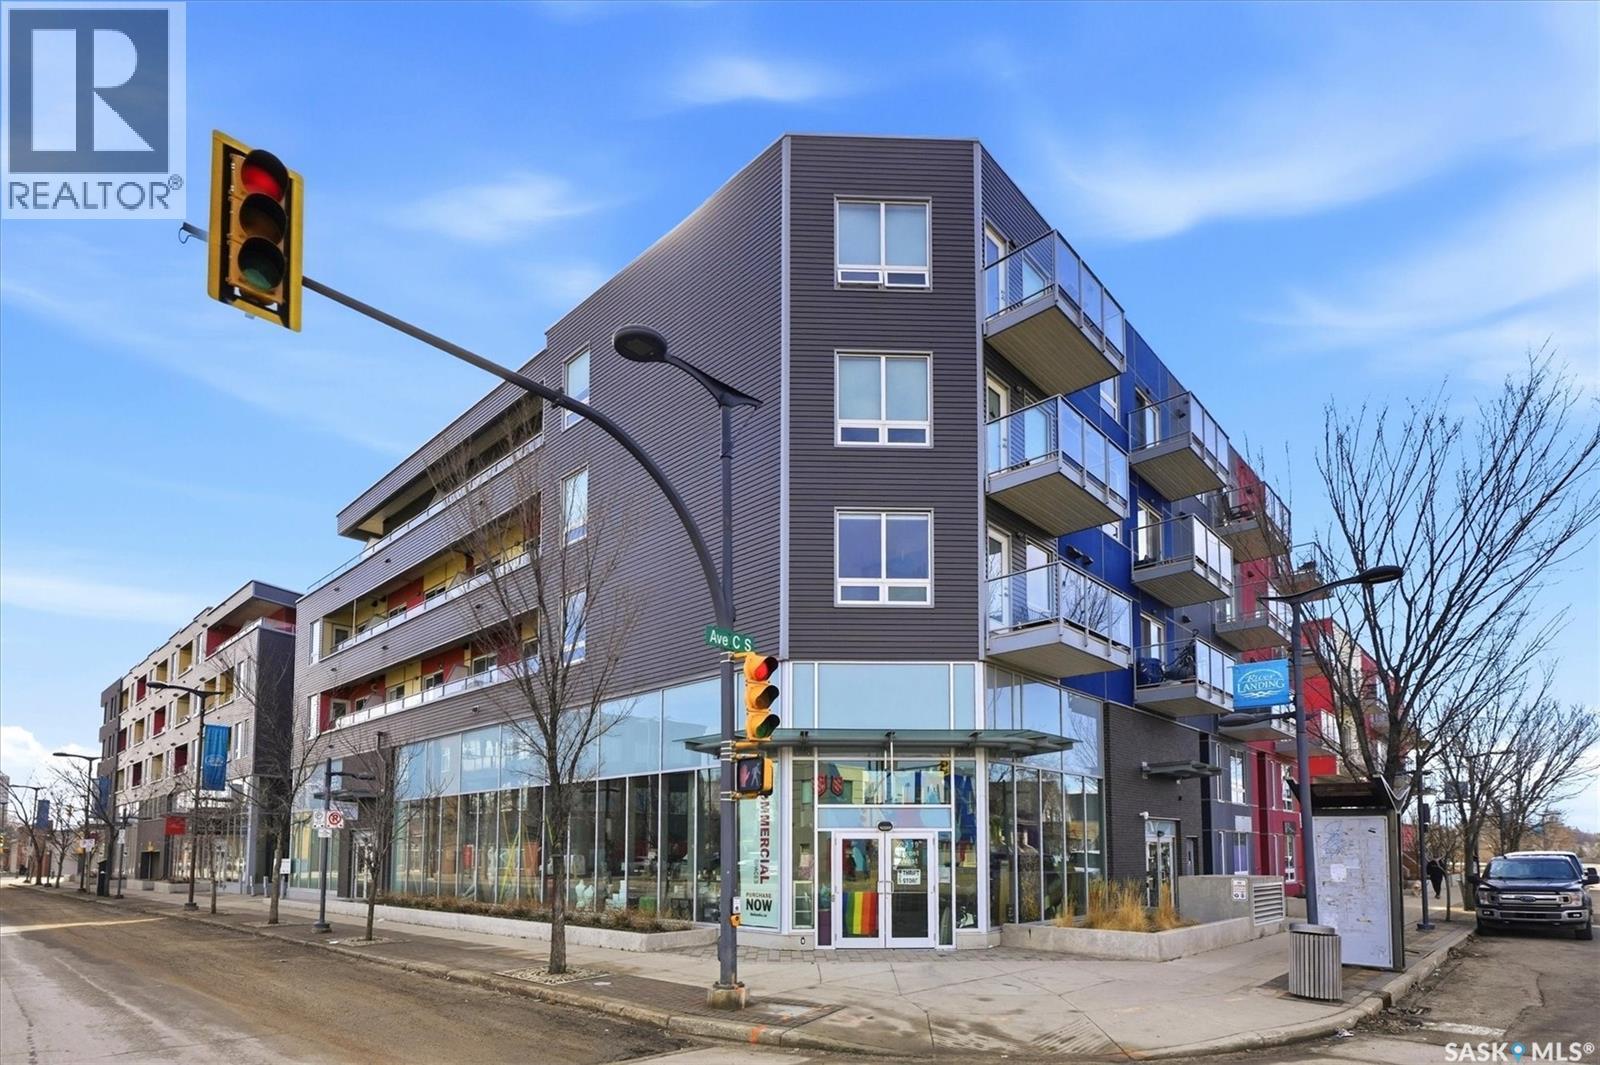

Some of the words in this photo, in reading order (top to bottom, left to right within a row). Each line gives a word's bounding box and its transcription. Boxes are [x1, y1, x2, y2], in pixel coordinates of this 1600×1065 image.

[709, 629, 729, 646] Ave
[732, 635, 740, 649] C
[744, 638, 752, 652] S
[1238, 679, 1285, 692] LANDING
[759, 797, 770, 885] MMERCIAL
[746, 898, 773, 912] NOW
